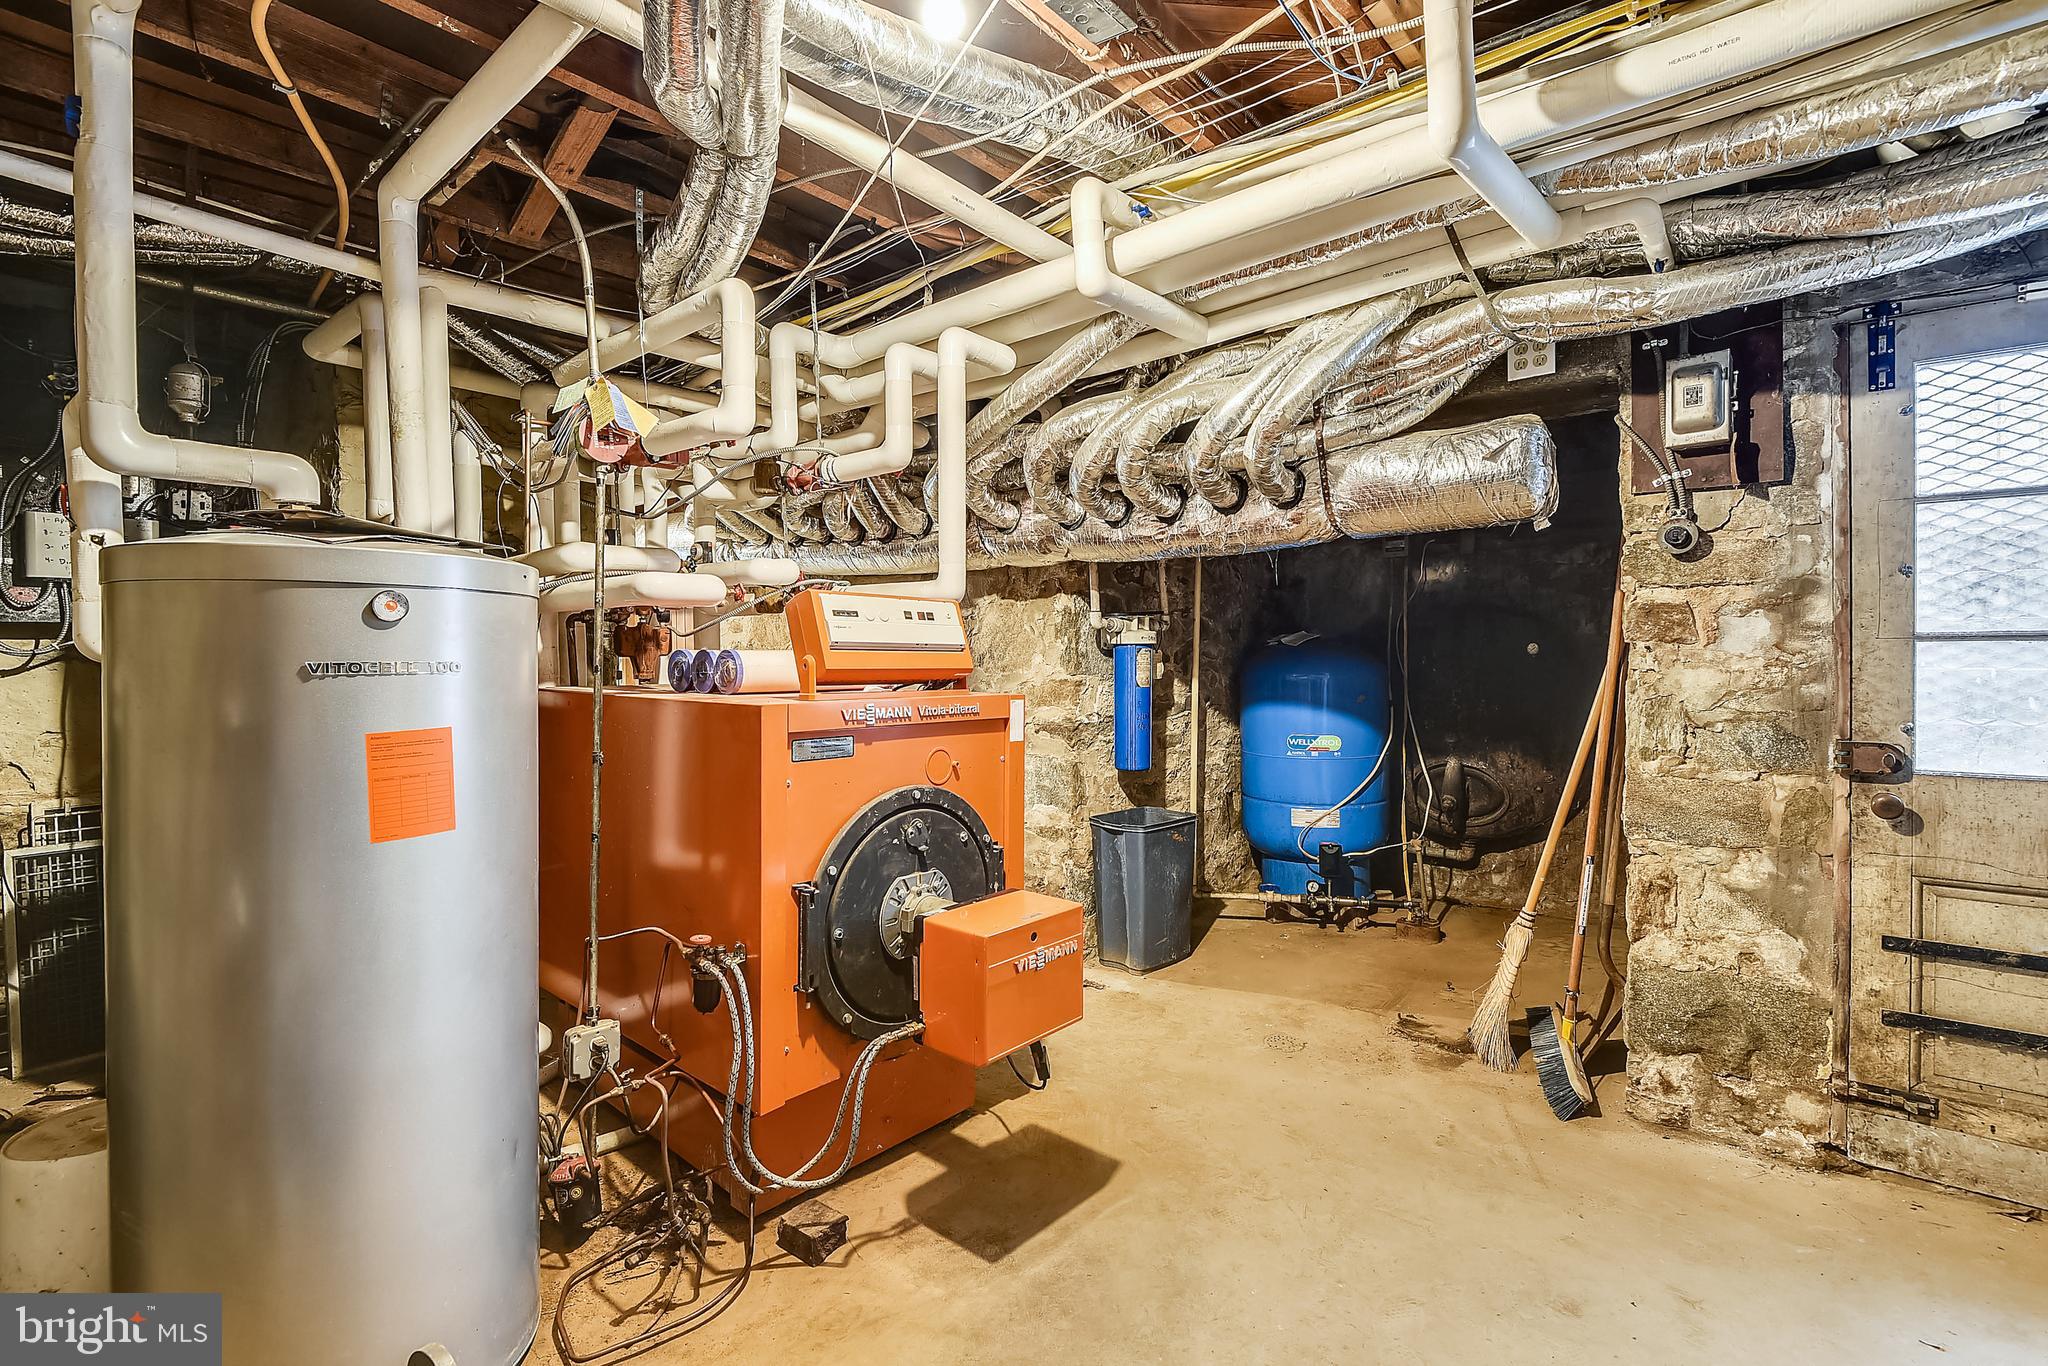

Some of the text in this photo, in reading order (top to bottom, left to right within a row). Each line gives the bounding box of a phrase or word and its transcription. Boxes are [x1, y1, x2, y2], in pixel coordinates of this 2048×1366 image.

[1668, 37, 1741, 66] HEATING HOT WATER
[306, 661, 463, 675] VITOCELL 100
[841, 702, 980, 725] VIESSMANN Vitola-biferral
[1014, 939, 1078, 974] VIESSMANN
